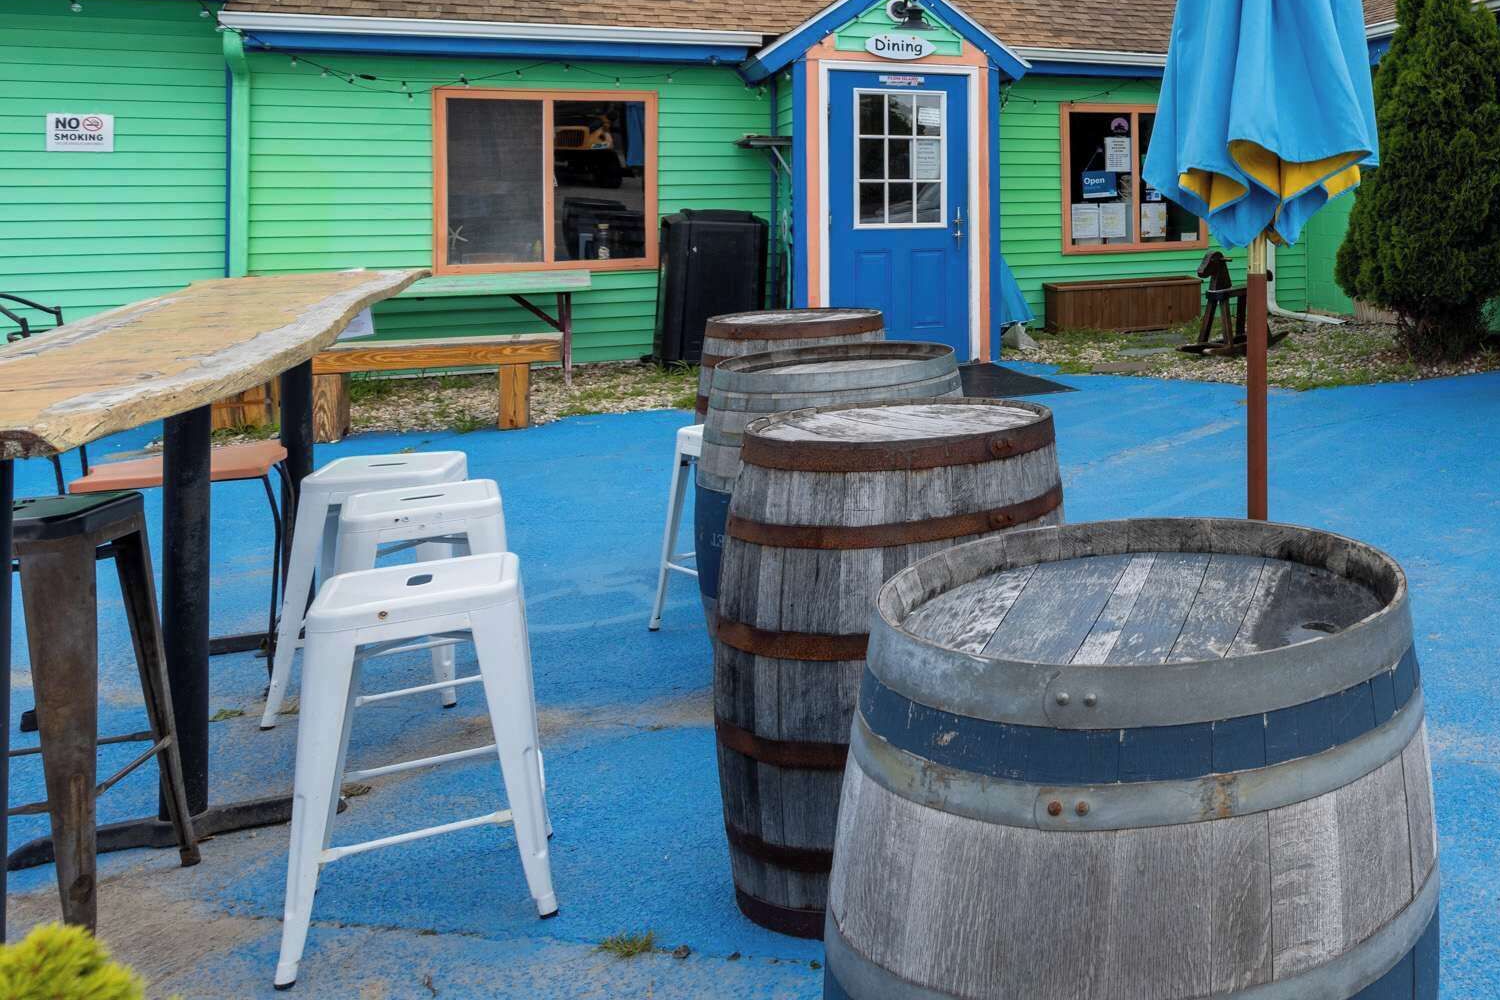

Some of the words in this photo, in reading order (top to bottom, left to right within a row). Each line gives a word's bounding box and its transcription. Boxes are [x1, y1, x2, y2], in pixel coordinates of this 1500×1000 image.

[875, 38, 923, 56] Dining
[55, 117, 80, 129] NO
[54, 133, 104, 141] SMOKING
[1083, 177, 1105, 186] Open
